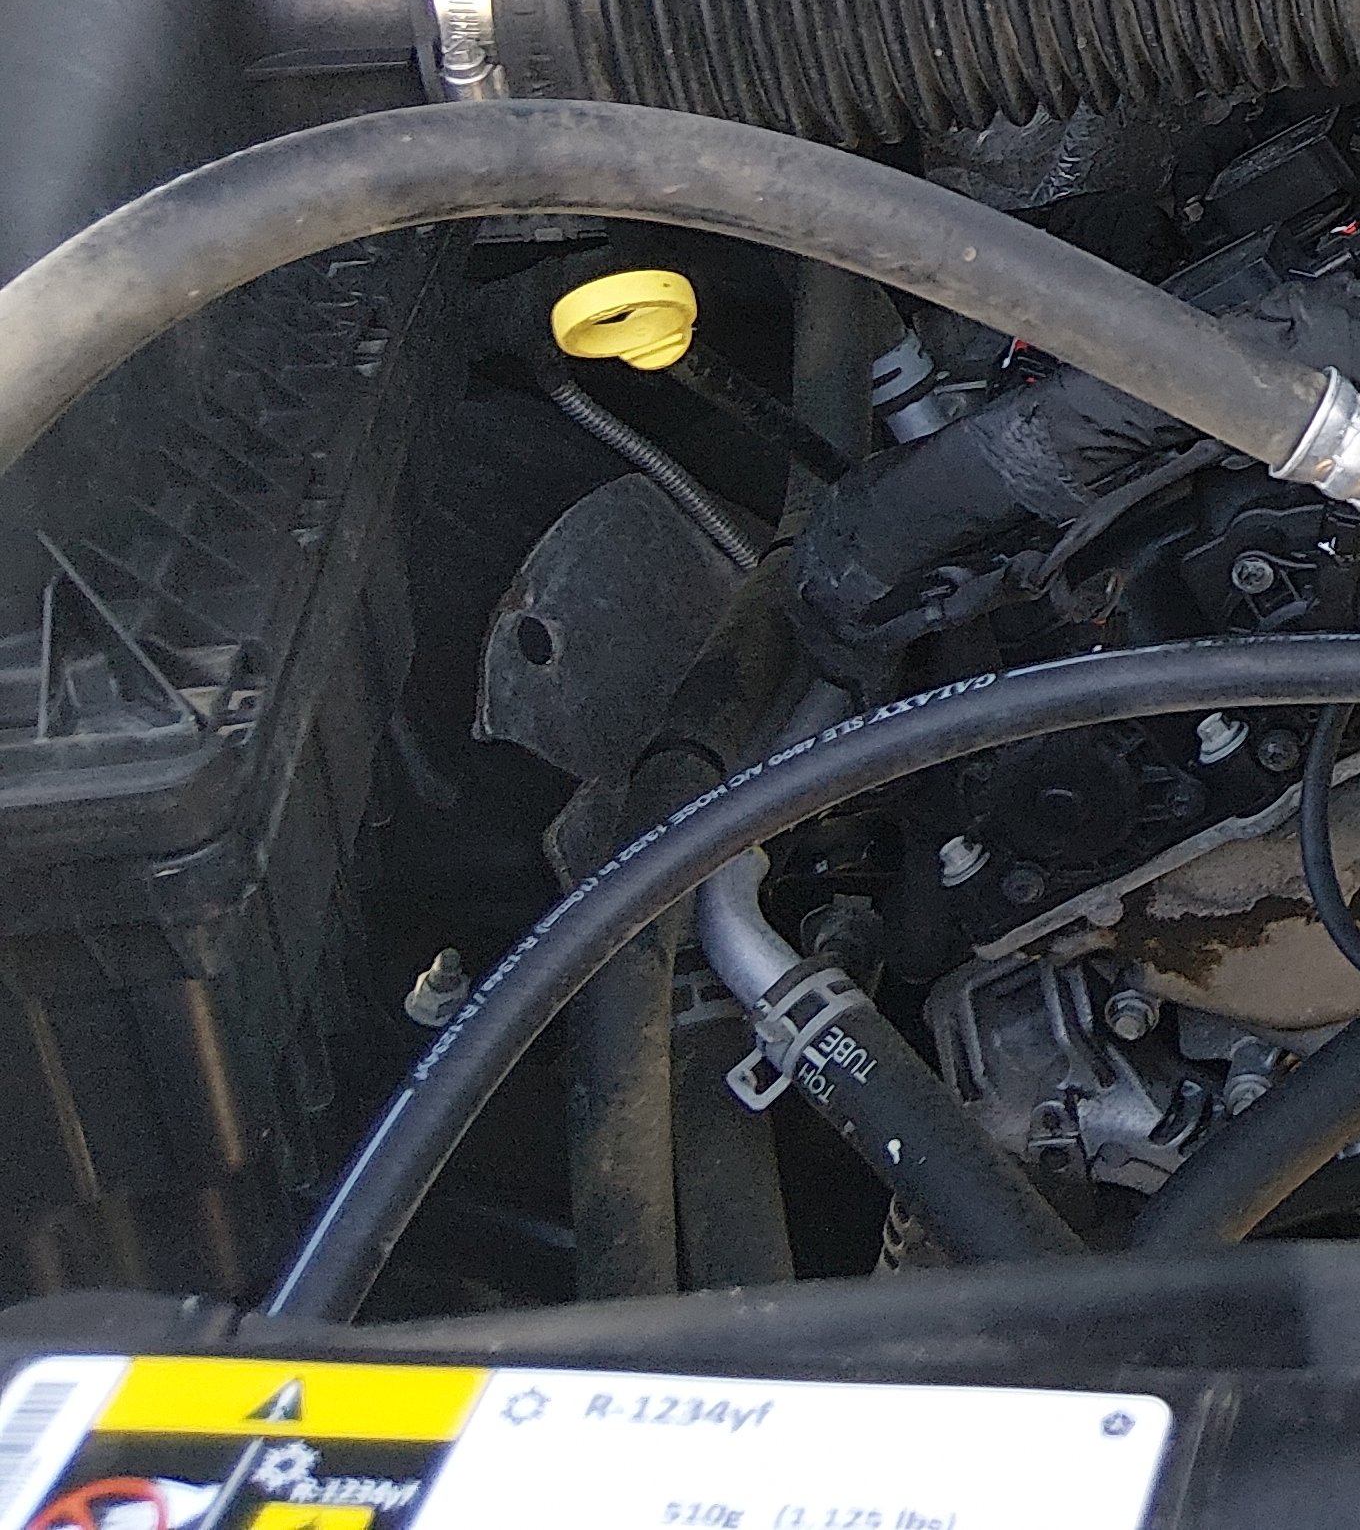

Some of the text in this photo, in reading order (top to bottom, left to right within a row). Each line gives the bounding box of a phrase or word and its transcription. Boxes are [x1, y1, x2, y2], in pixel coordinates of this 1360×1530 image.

[871, 672, 996, 724] GALAXY
[823, 715, 867, 742] SLE
[668, 786, 728, 827] HOSE
[820, 1024, 879, 1085] TUBE
[585, 1392, 775, 1433] R-1234yf
